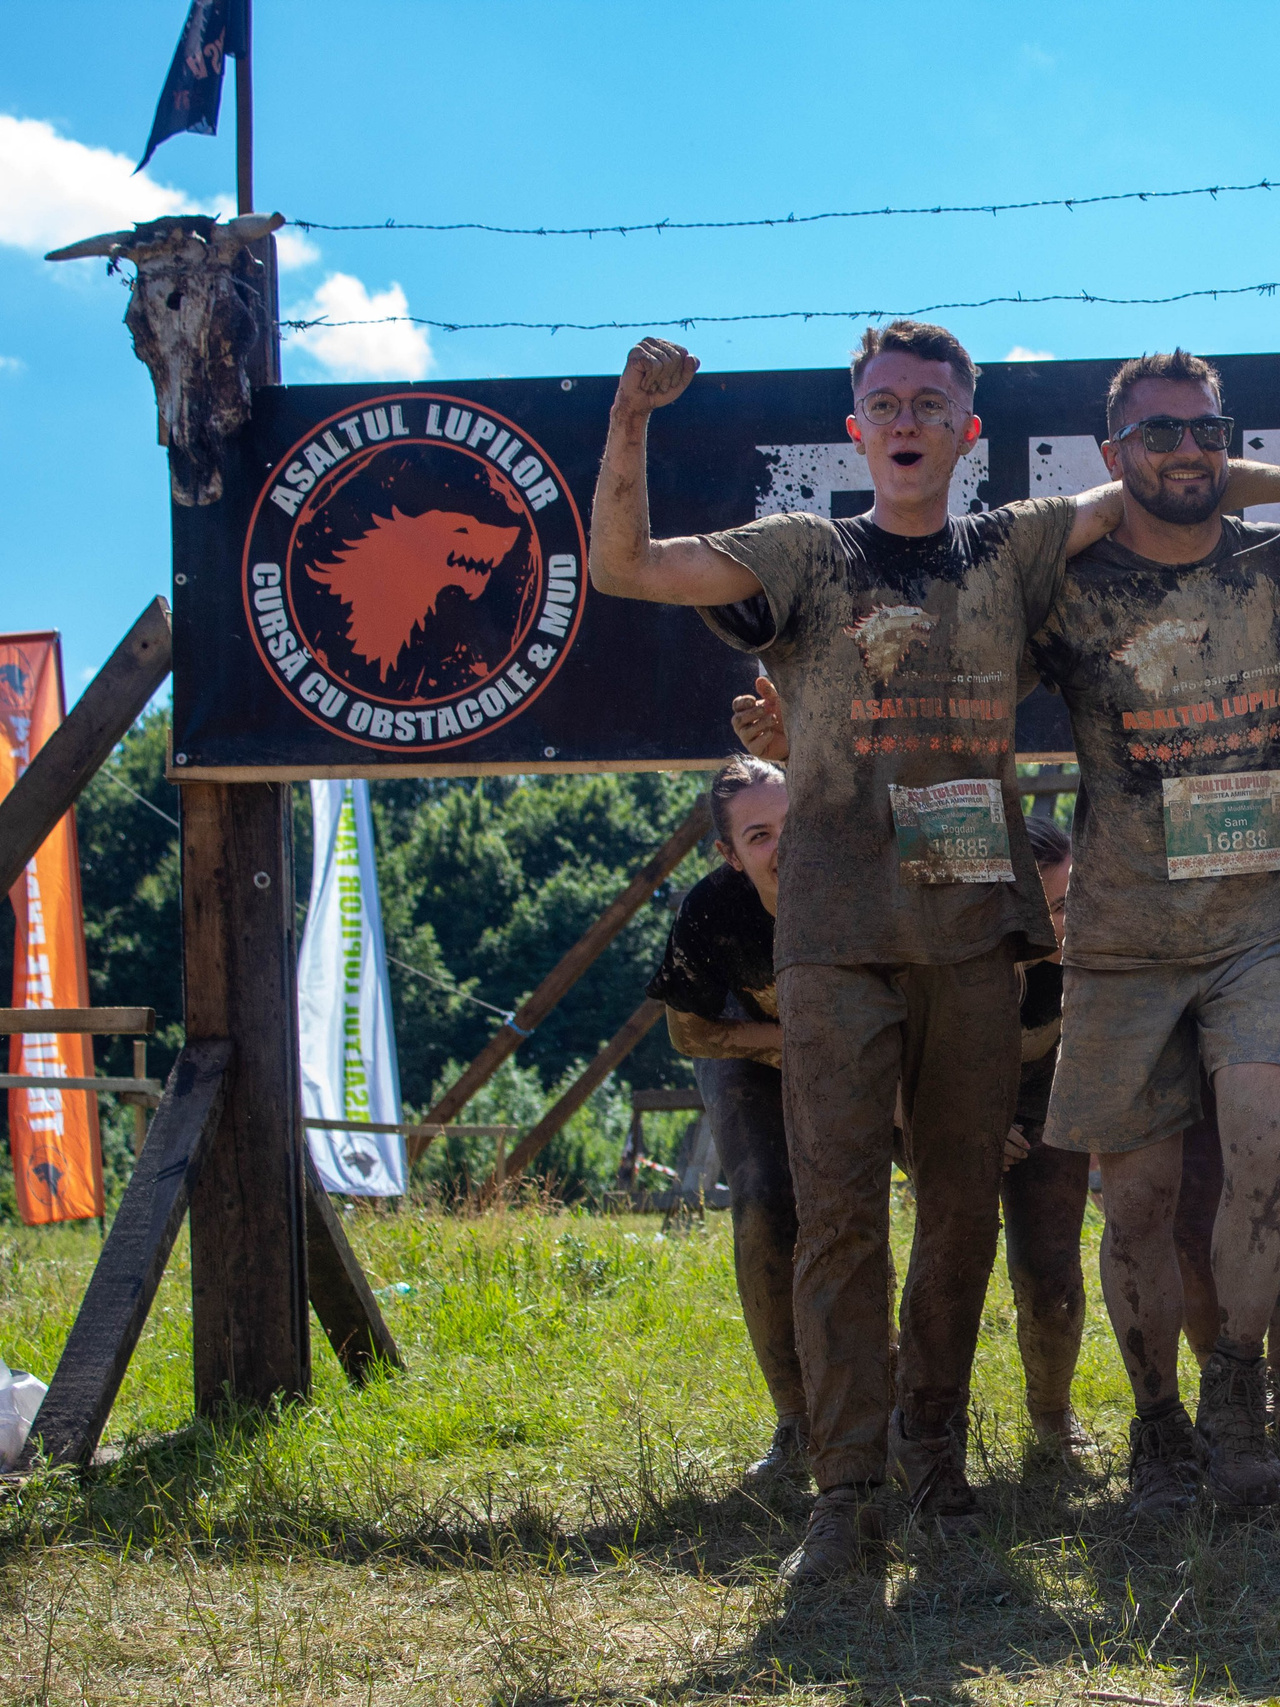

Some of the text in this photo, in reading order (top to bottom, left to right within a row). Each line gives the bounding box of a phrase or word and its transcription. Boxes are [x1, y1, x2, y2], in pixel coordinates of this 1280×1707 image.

[270, 404, 559, 517] ASALTUL LUPILOR
[252, 553, 577, 741] CURSĂ CU OBSTACOLE & MUD
[1121, 701, 1219, 730] ASALTUL
[941, 824, 976, 837] Bogdan
[1224, 818, 1248, 828] Sam
[932, 838, 989, 859] 16885
